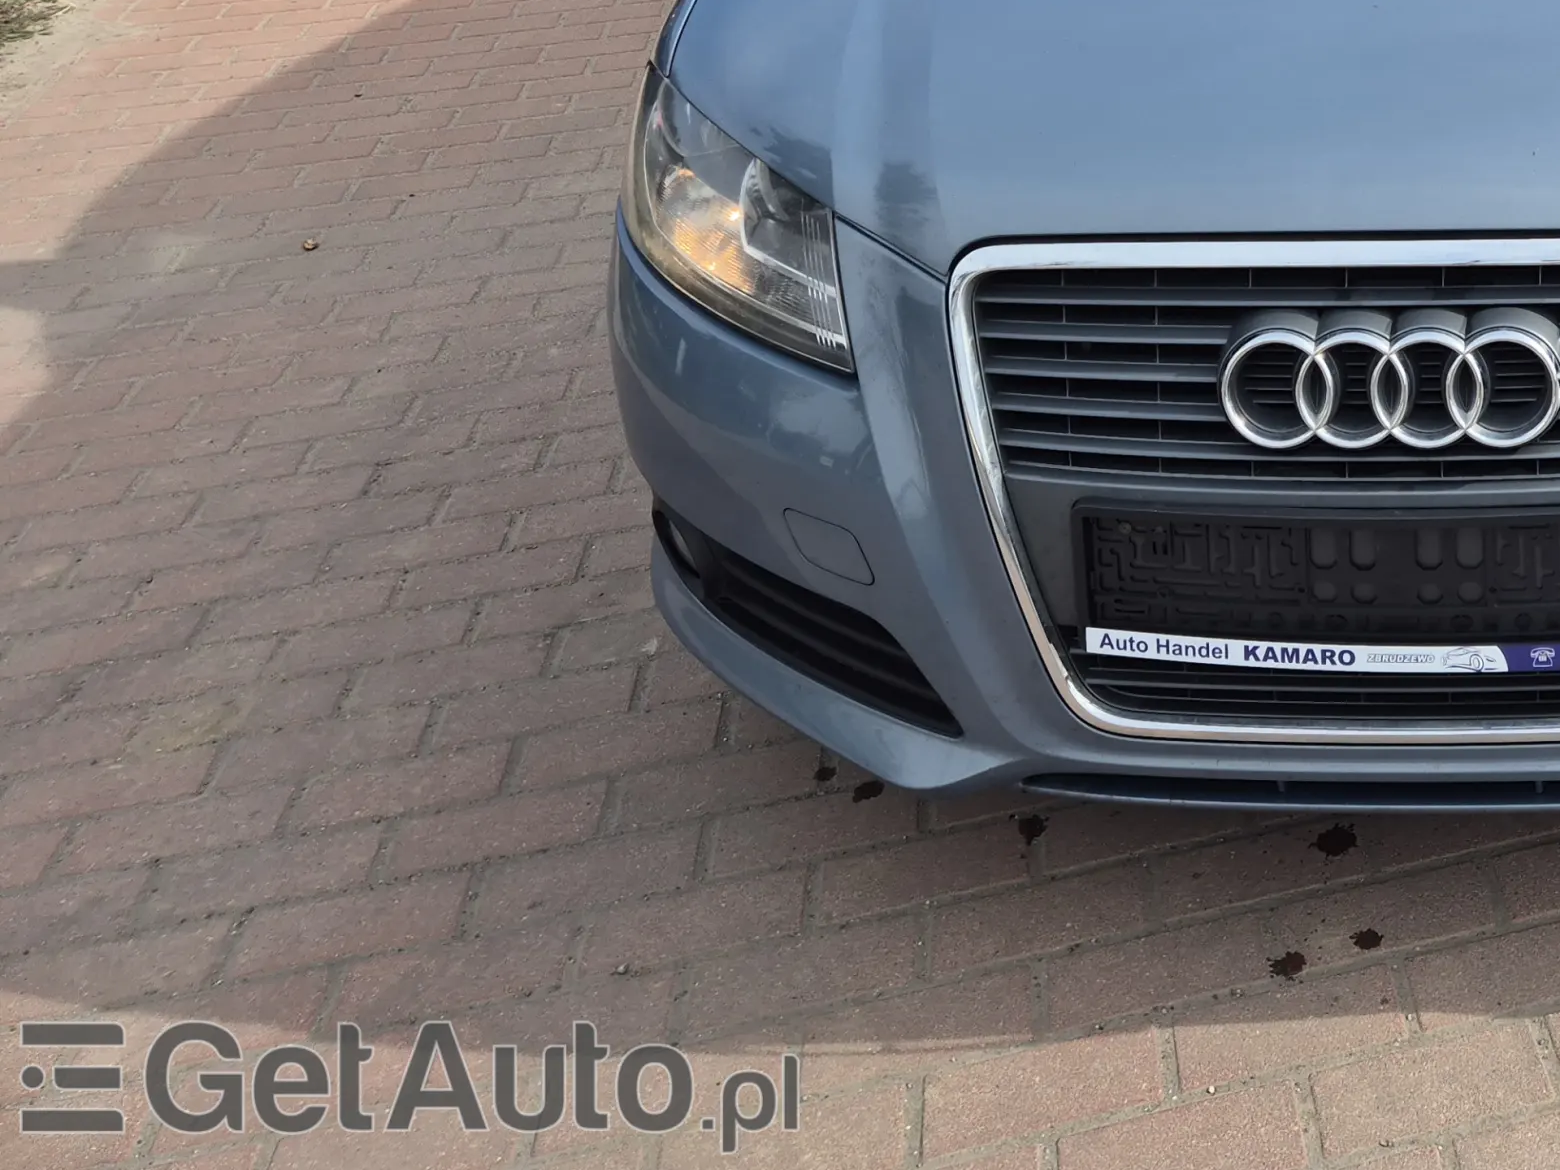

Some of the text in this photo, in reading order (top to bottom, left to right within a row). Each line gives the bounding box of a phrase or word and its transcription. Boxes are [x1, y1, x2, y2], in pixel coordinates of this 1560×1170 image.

[1099, 633, 1149, 653] Auto
[1156, 638, 1229, 660] Handel
[1243, 645, 1356, 666] KAMARO
[1366, 653, 1436, 664] ZBRUDZEWO
